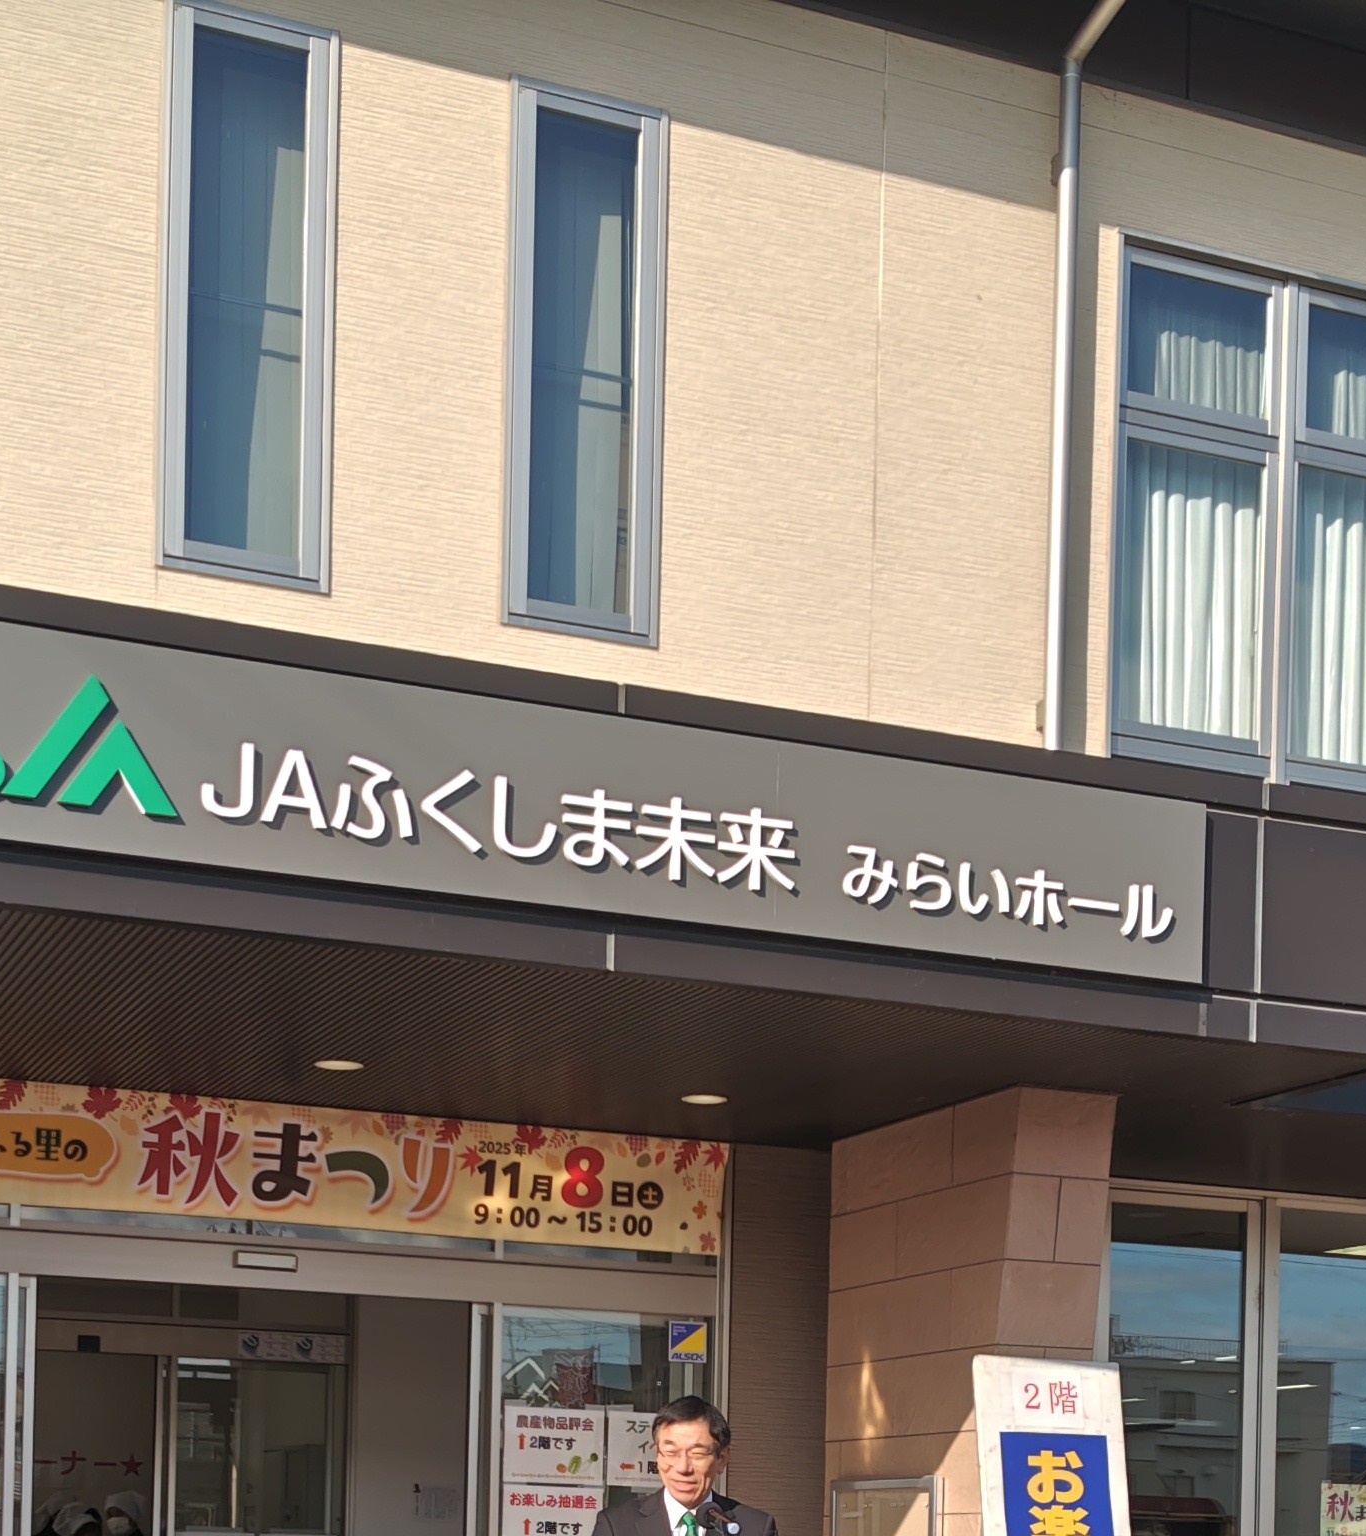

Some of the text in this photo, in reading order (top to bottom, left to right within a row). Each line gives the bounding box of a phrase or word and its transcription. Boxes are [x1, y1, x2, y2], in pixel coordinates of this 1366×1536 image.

[200, 742, 1175, 939] JAふくしま未来 みらいホール
[478, 1140, 528, 1157] 2025年
[137, 1111, 452, 1214] 秋まつり
[671, 1352, 704, 1362] ALSOK
[1023, 1380, 1079, 1416] 2階
[516, 1414, 595, 1432] 農産物品評会
[529, 1435, 577, 1451] 2階です
[509, 1492, 598, 1510] お楽しみ抽選会
[535, 1520, 583, 1536] 2階です
